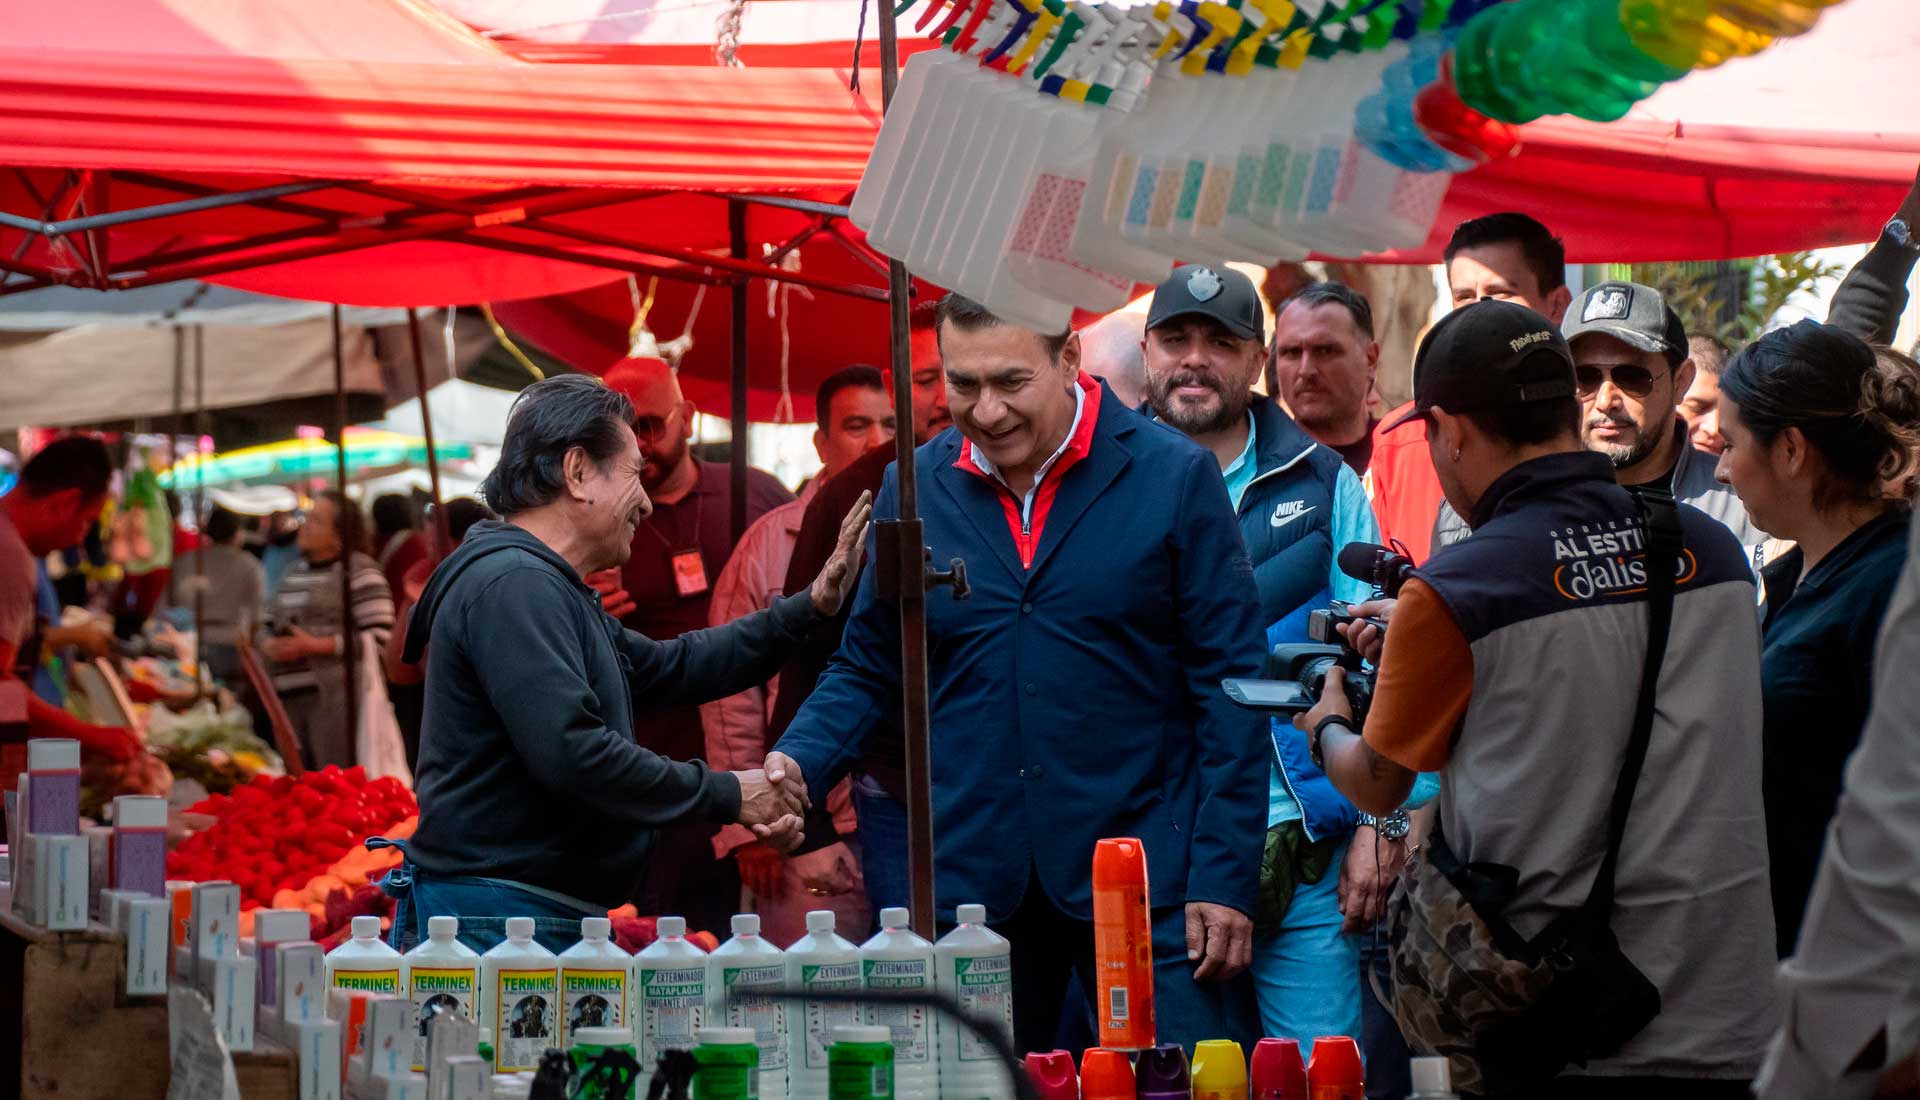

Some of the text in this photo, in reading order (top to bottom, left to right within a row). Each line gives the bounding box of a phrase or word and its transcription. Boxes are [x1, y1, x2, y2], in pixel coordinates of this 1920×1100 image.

[1275, 500, 1304, 517] NIKE
[1554, 528, 1647, 560] AL ESTI
[1571, 556, 1686, 599] Jalis
[338, 977, 395, 991] TERMINEX
[414, 975, 471, 990] TERMINEX
[565, 976, 622, 991] TERMINEX
